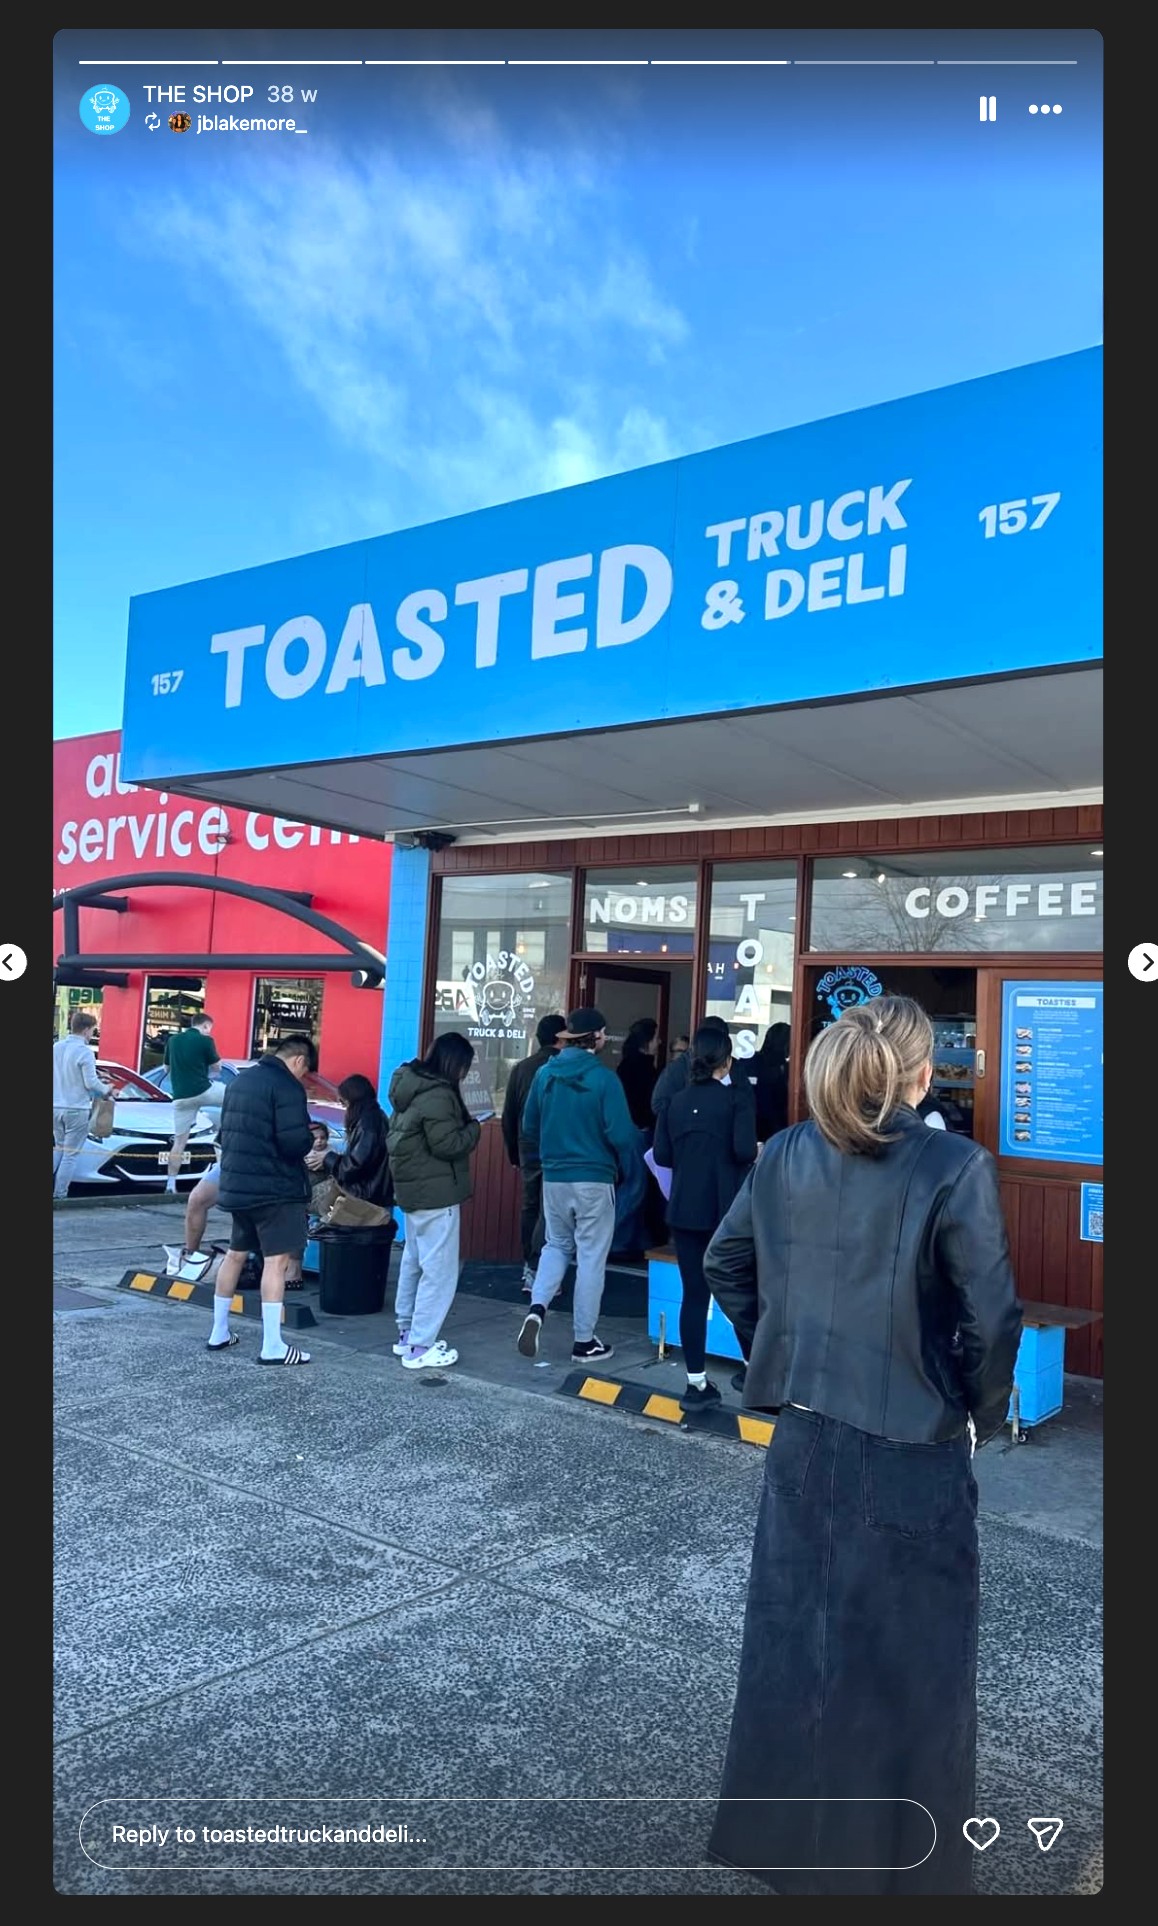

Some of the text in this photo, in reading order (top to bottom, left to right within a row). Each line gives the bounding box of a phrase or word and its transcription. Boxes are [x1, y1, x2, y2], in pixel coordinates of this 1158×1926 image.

[704, 478, 914, 566] TRUCK
[978, 492, 1061, 539] 157
[700, 543, 908, 631] & DELI
[210, 543, 674, 709] TOASTED
[150, 670, 184, 696] 157
[57, 796, 229, 864] service
[590, 896, 688, 924] NOMS
[905, 881, 1098, 919] COFFEE
[466, 950, 535, 993] TOASTED
[735, 893, 766, 1084] TOAS
[816, 966, 883, 997] TOASTED
[467, 1028, 526, 1038] TRUCK & DELI
